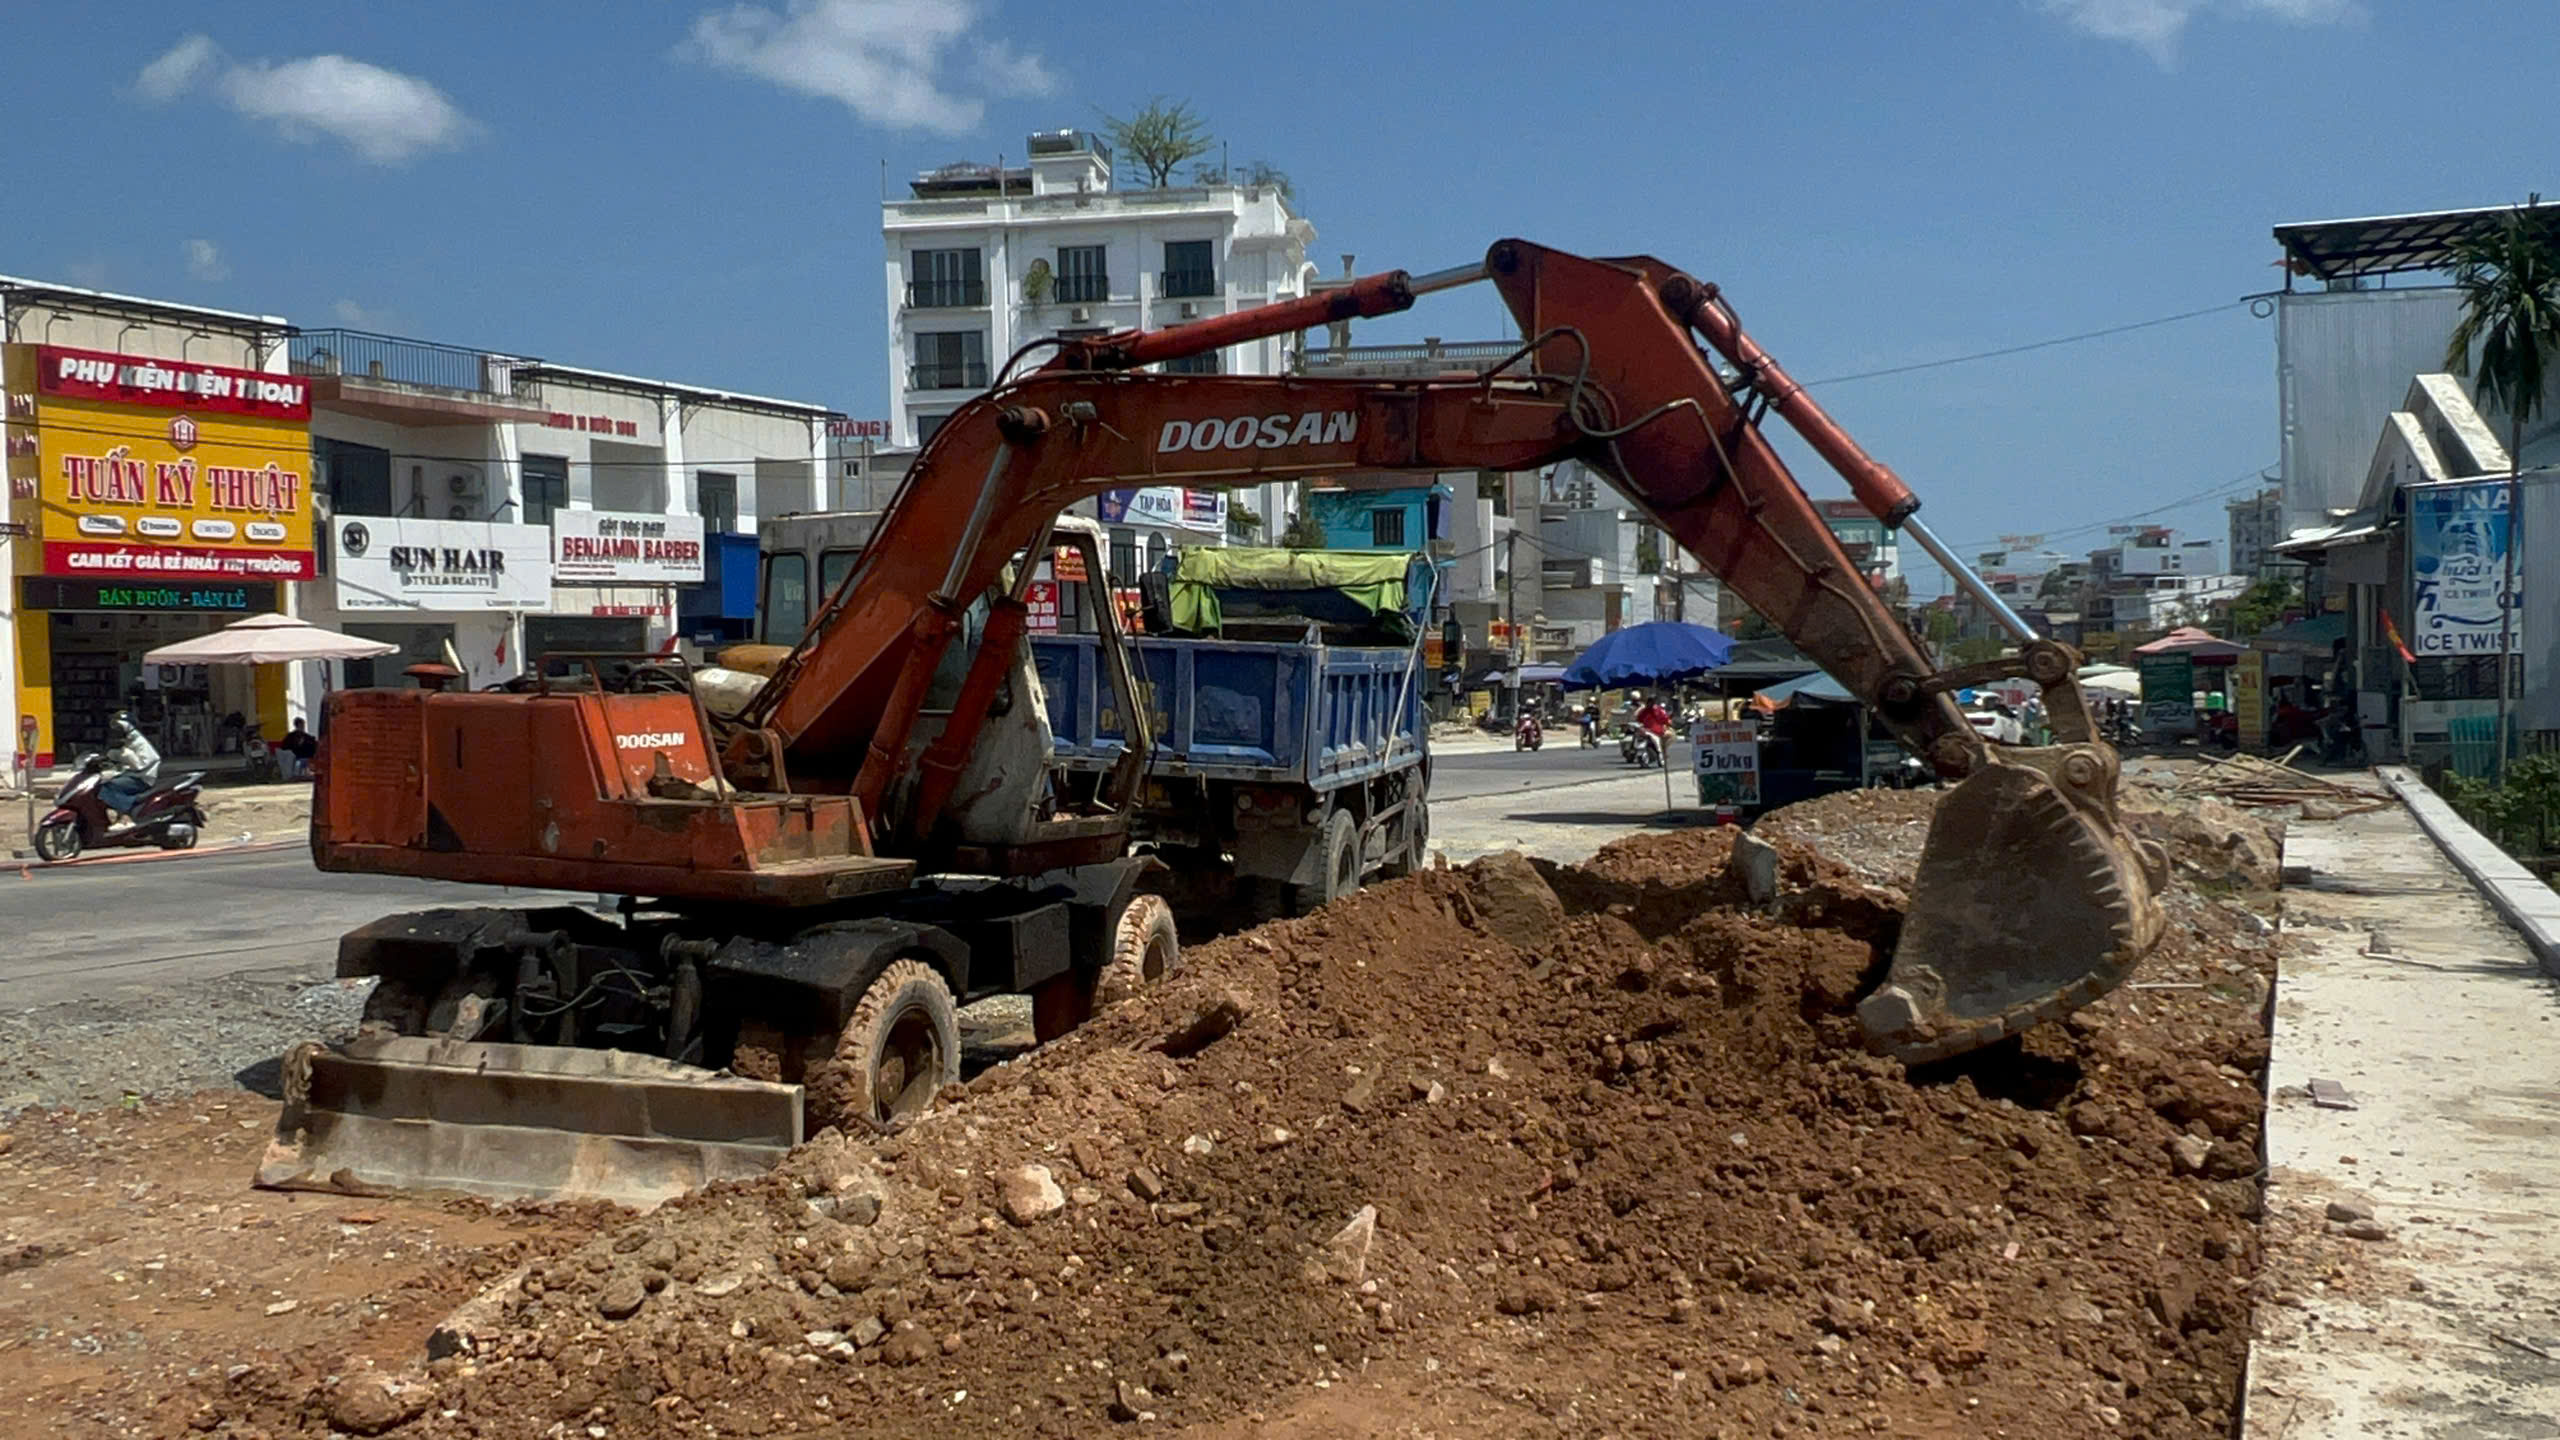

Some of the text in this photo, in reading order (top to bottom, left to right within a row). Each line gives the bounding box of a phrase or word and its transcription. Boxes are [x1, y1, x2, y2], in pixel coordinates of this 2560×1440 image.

[60, 357, 115, 388] PHỤ
[118, 361, 174, 393] KIỆN
[236, 378, 304, 408] THOẠI
[1157, 410, 1357, 453] DOOSAN
[156, 457, 197, 507] KỸ
[207, 461, 299, 518] THUẬT
[390, 546, 505, 572] SUN HAIR
[563, 537, 700, 560] BENJAMIN BARBER
[68, 553, 103, 568] CAM
[2418, 634, 2452, 651] ICE
[616, 732, 685, 749] DOOSAN
[1700, 748, 1714, 768] 5
